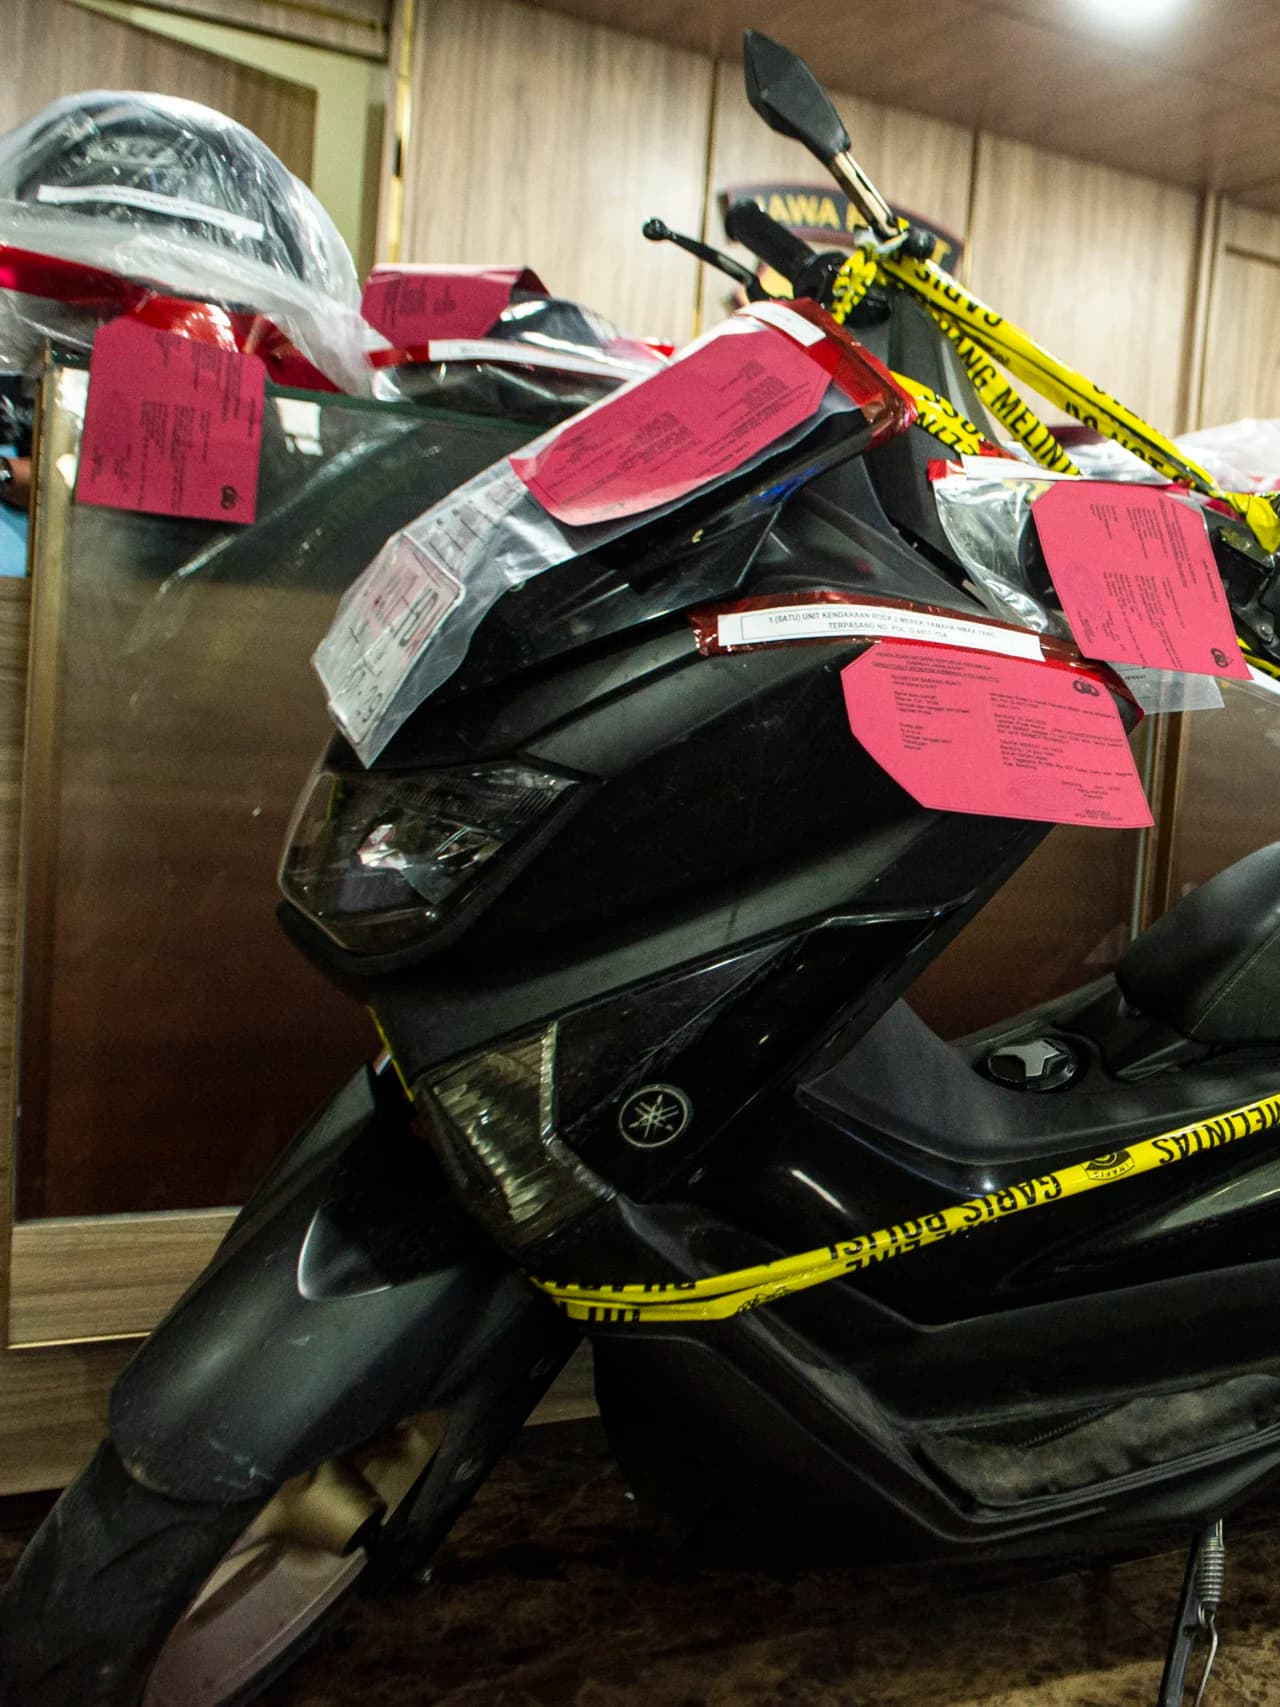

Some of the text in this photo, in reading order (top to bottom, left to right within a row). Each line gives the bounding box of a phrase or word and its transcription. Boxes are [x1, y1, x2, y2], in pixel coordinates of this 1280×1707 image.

[774, 613, 801, 625] (SATU)
[802, 612, 820, 623] UNIT
[959, 1174, 1063, 1222] GARIS
[827, 1213, 948, 1260] POLISI
